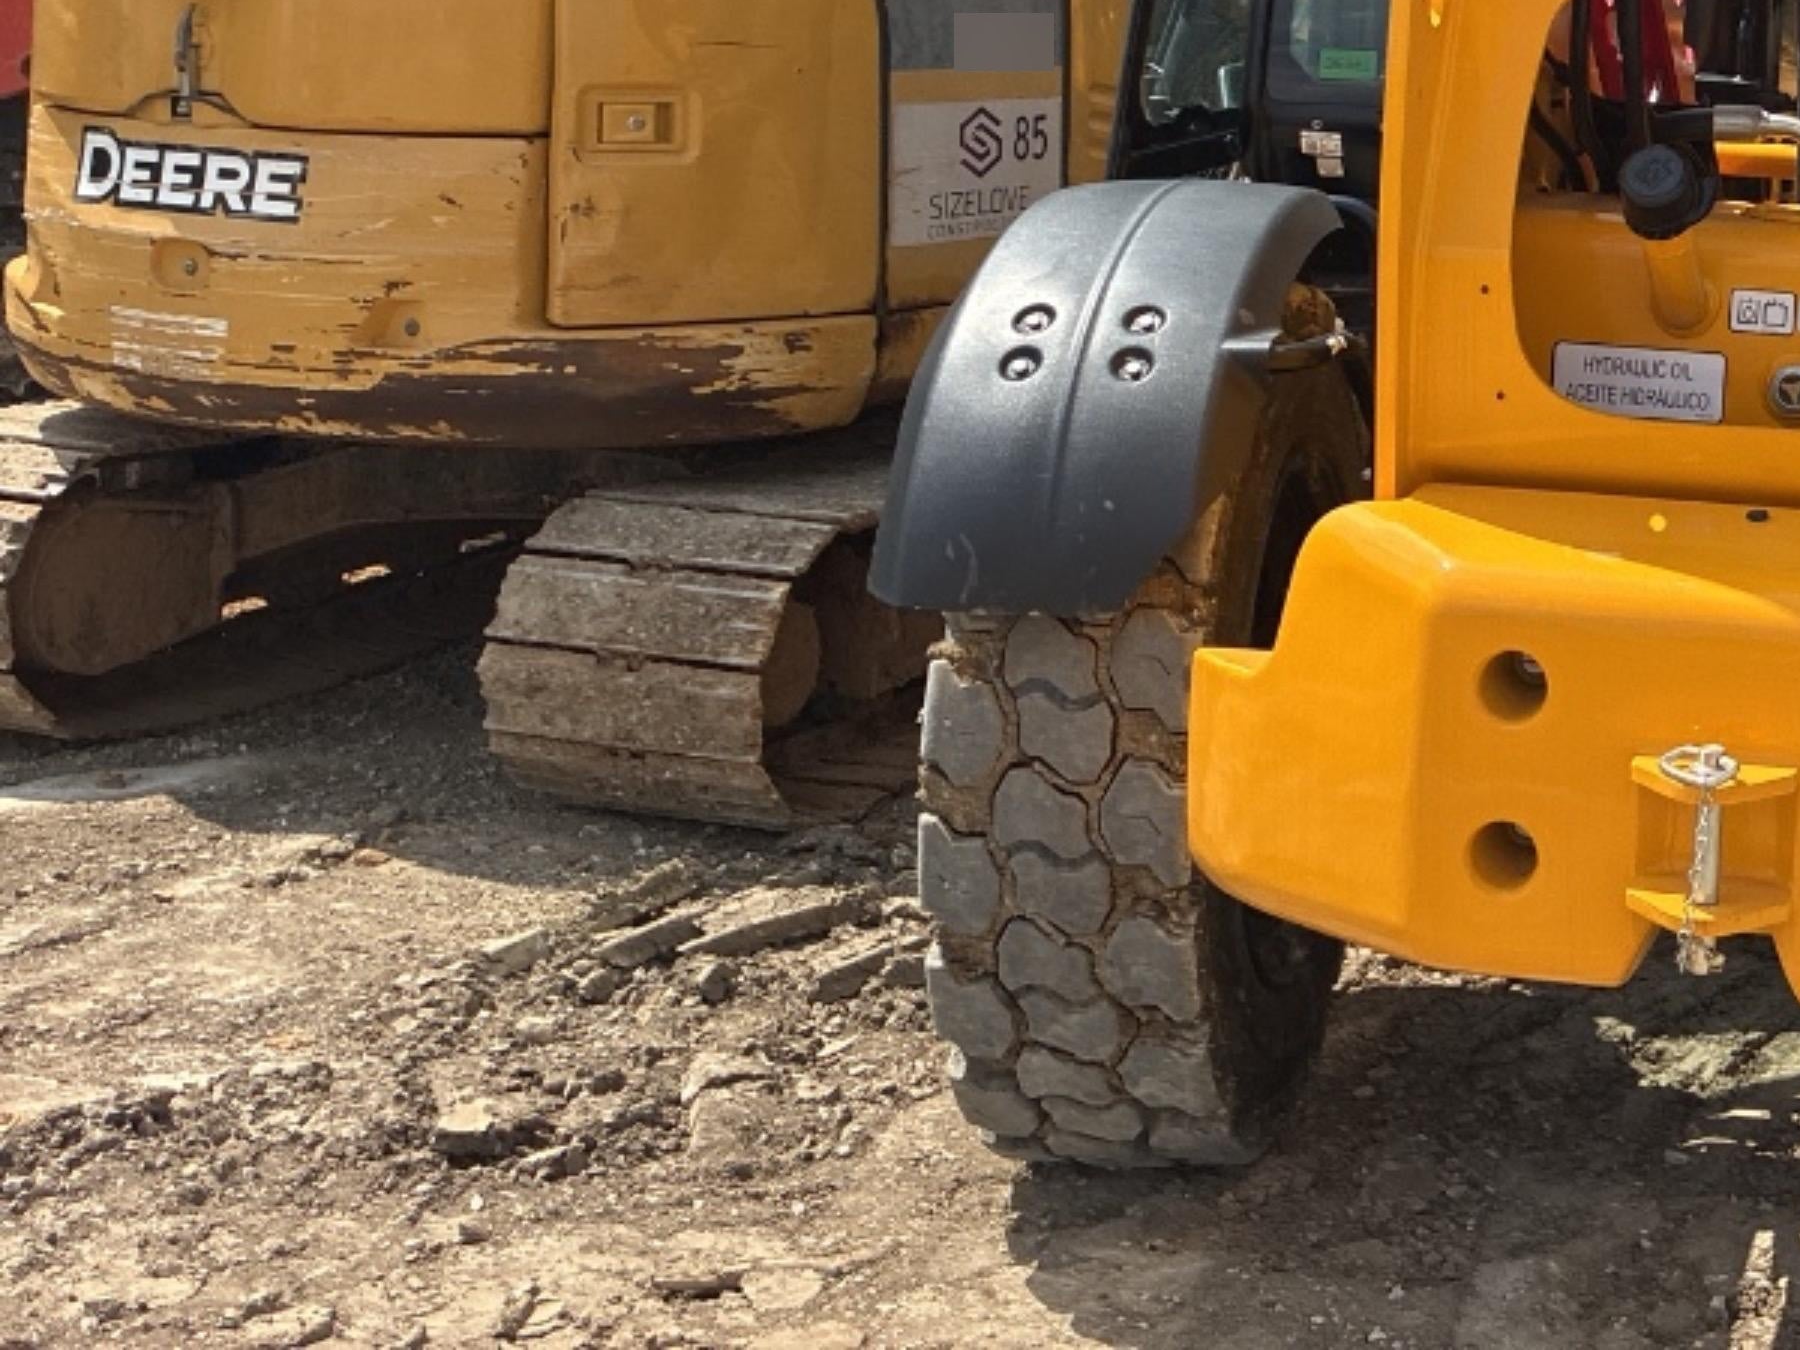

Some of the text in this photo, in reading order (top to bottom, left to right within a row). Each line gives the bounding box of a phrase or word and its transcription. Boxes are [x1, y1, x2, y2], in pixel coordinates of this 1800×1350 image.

[1014, 114, 1049, 160] 85
[76, 130, 303, 217] DEERE
[1584, 355, 1666, 379] HYDRAULIC
